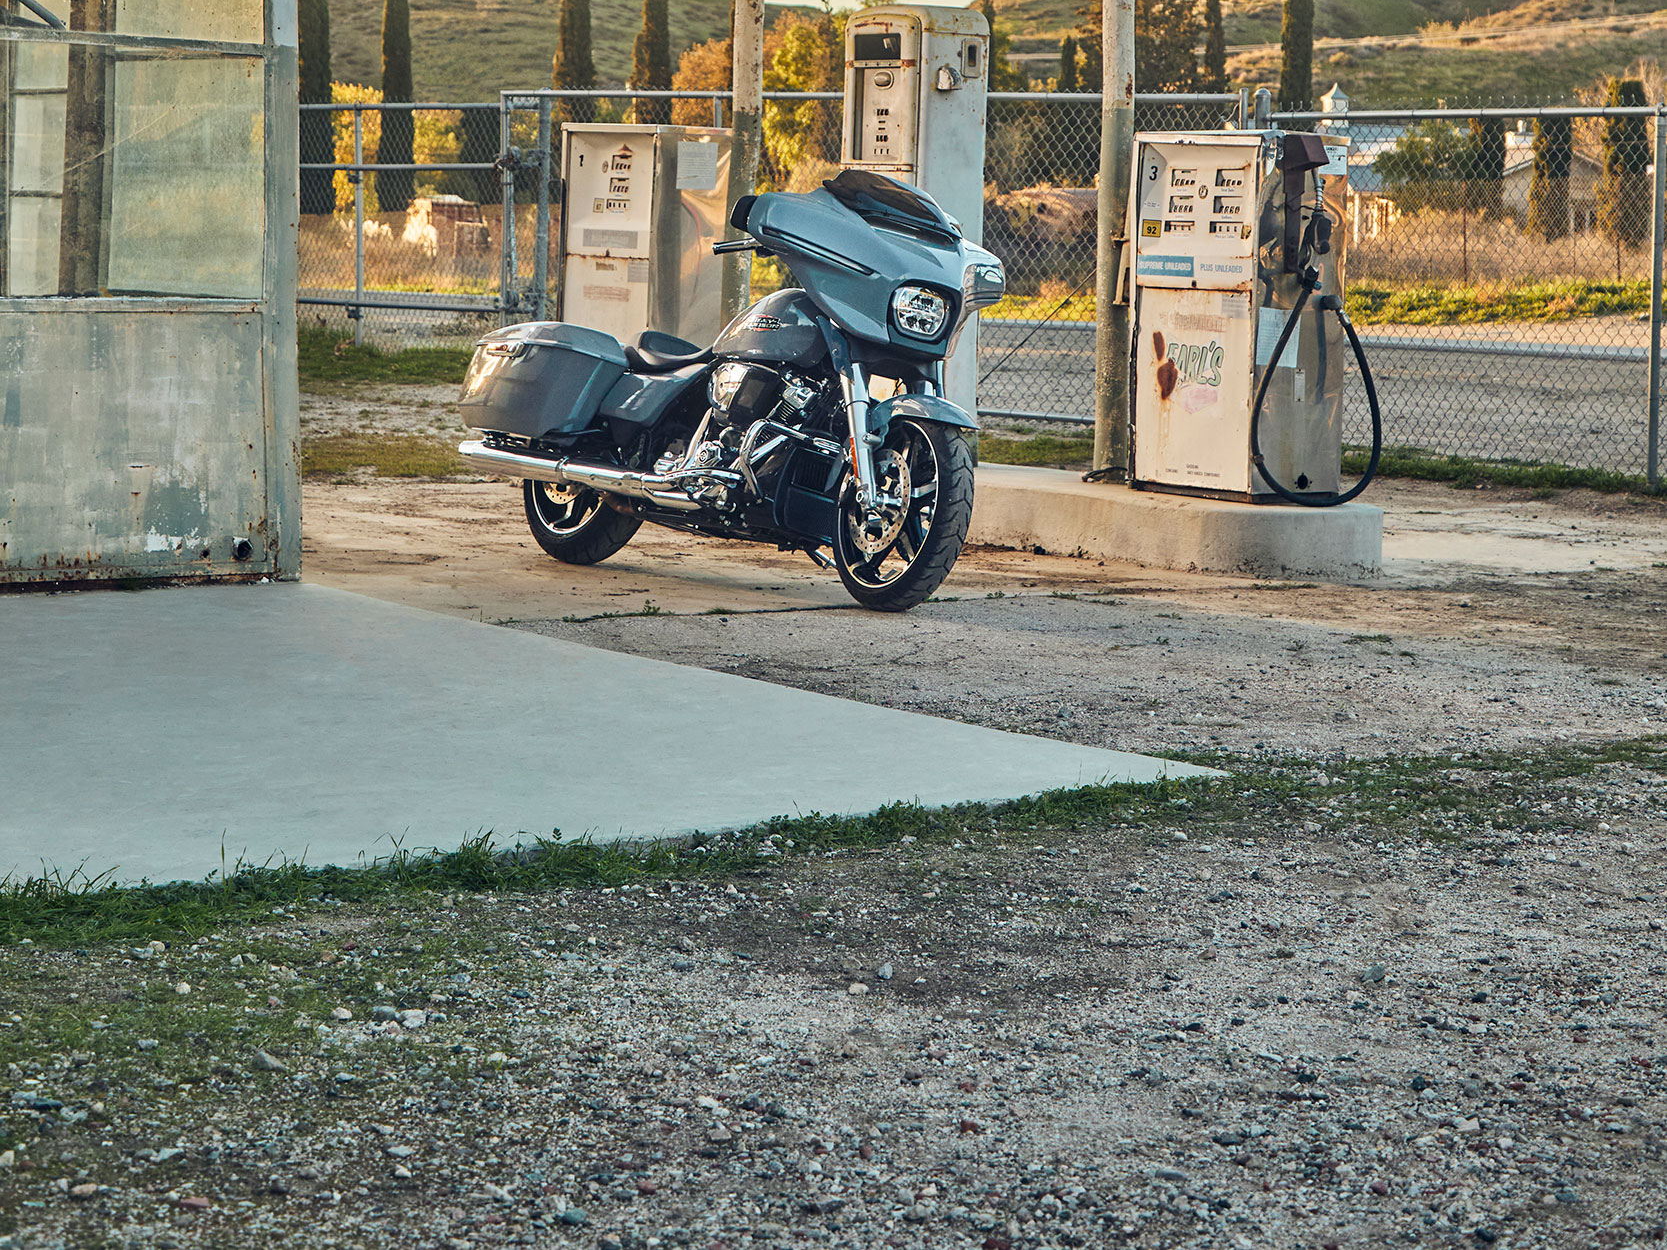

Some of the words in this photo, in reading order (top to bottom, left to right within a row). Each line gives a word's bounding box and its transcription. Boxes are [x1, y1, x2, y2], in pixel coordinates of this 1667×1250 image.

[579, 154, 584, 167] 1
[1149, 165, 1159, 181] 3
[1146, 225, 1157, 235] 92
[1139, 260, 1164, 270] SUPREME
[1164, 261, 1192, 271] UNLEADED
[1200, 263, 1213, 272] PLUS
[1214, 264, 1243, 274] UNLEADED
[1166, 340, 1225, 387] EARL'S
